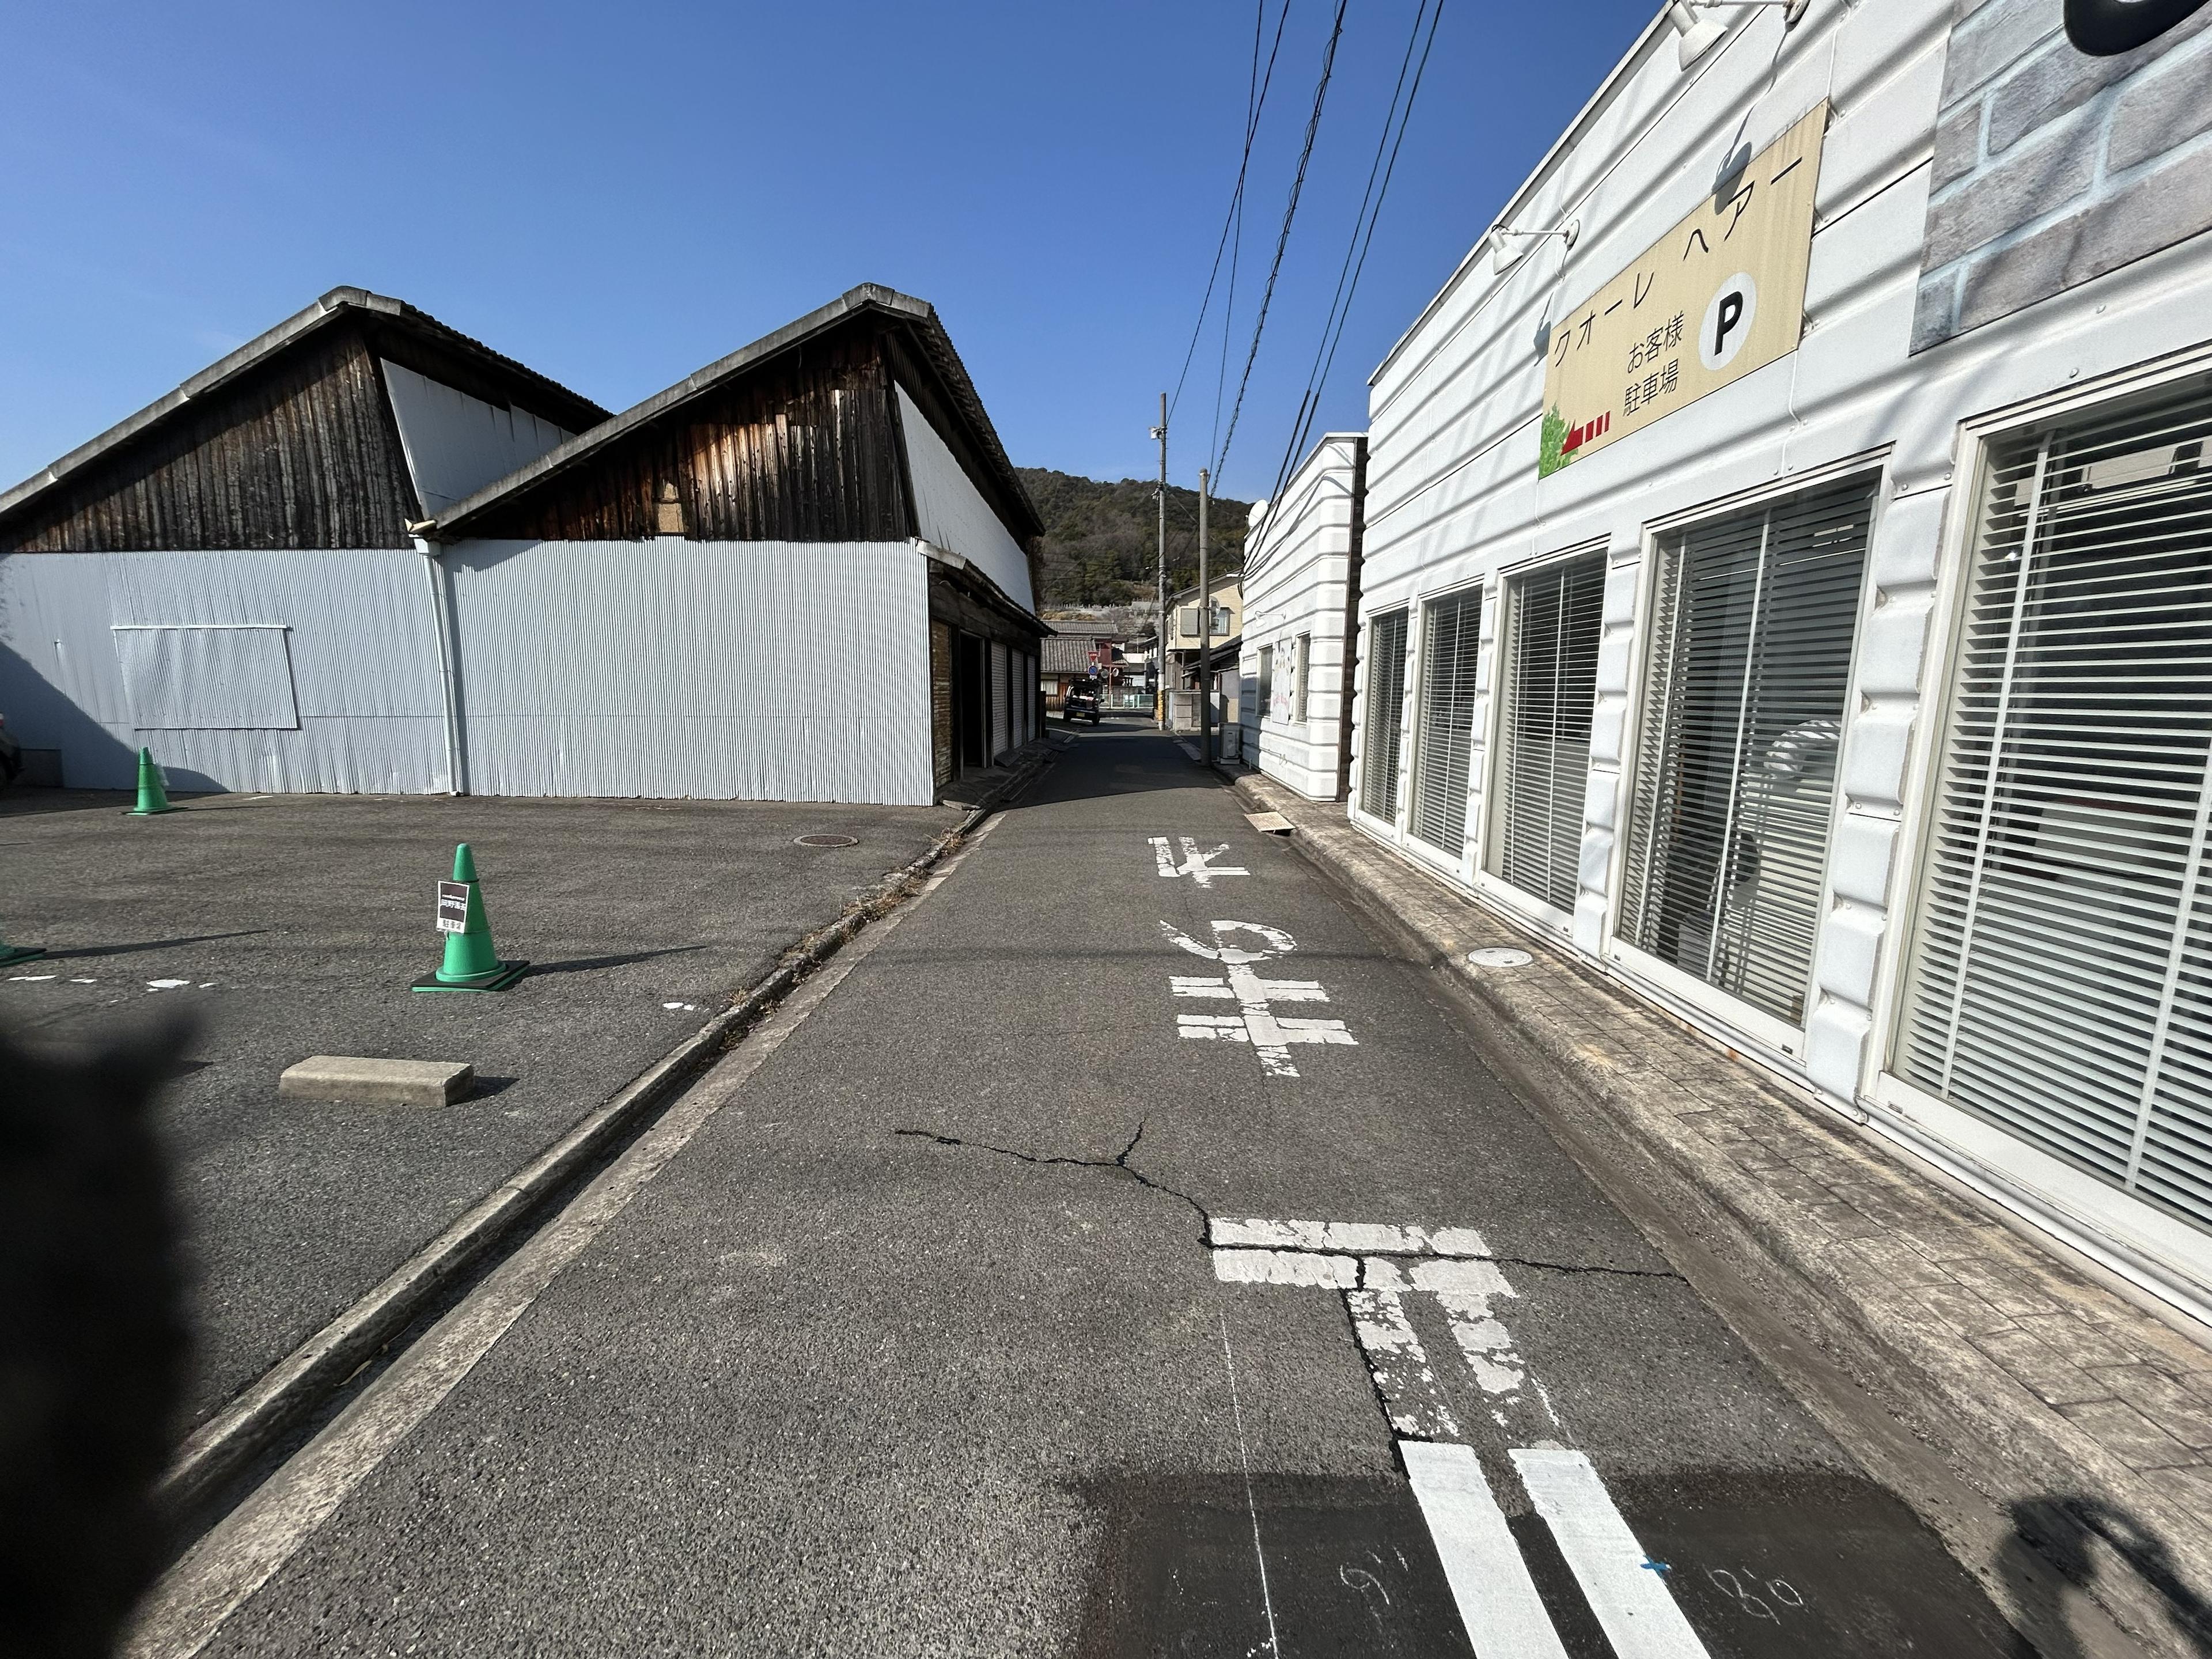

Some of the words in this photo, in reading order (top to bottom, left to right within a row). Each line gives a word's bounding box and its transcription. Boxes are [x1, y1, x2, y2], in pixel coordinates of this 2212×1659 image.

[1554, 271, 1655, 368] クオーレ
[1682, 156, 1803, 262] ヘアー
[1627, 310, 1684, 374] お客様
[1714, 290, 1744, 356] P
[1622, 358, 1680, 418] 駐車場
